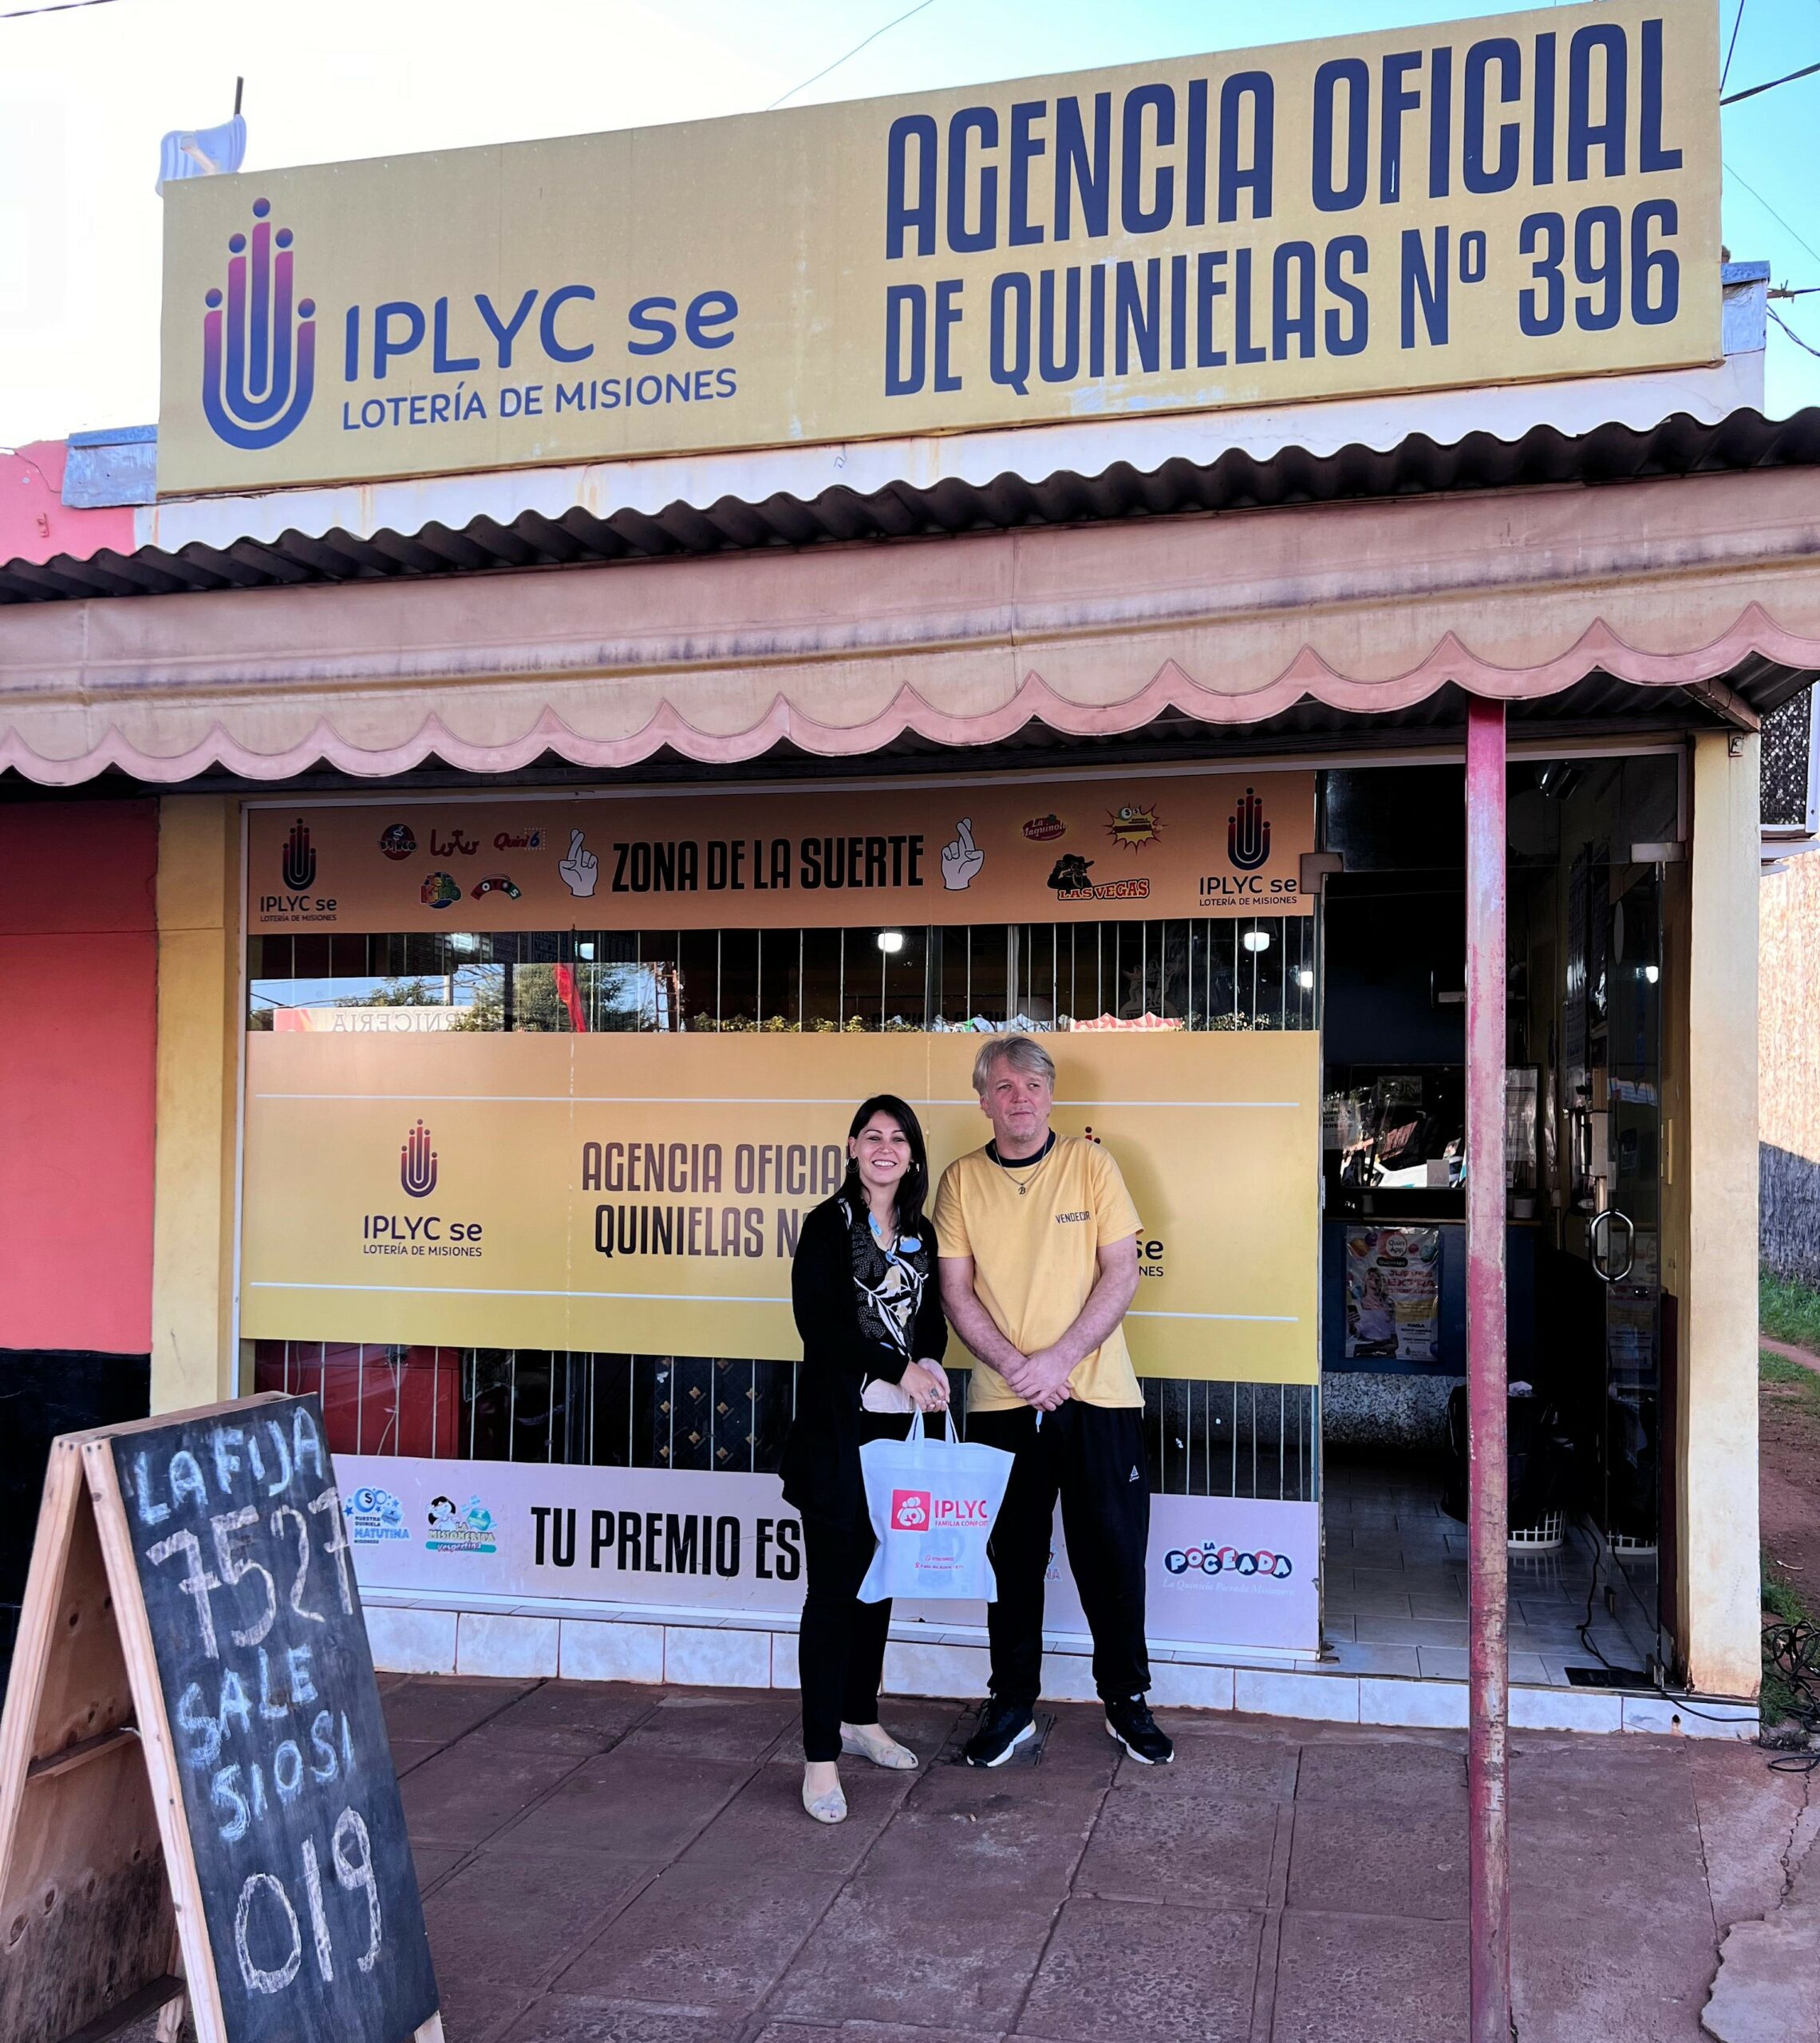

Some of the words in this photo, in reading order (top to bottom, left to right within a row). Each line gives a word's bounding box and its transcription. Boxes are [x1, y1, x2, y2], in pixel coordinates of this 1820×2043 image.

[886, 70, 1274, 260] AGENCIA
[1312, 18, 1683, 212] OFICIAL
[885, 279, 963, 396] DE
[989, 235, 1368, 395] QUINIELAS
[1518, 199, 1679, 337] 396
[345, 284, 595, 382] IPLYC
[627, 289, 739, 356] se
[342, 381, 487, 430] LOTERÍA
[499, 385, 543, 417] DE
[555, 367, 737, 414] MISIONES
[612, 840, 698, 892] ZONA
[707, 840, 745, 891] DE
[753, 838, 791, 889] LA
[800, 835, 924, 889] SUERTE
[1059, 888, 1093, 899] LAS
[1095, 879, 1149, 898] VEGAS
[1200, 876, 1263, 895] IPLYC
[1269, 879, 1297, 892] se
[260, 895, 310, 912] IPLYC
[315, 897, 337, 911] se
[1199, 896, 1237, 907] LOTERÍA
[1253, 895, 1297, 905] MISIONES
[582, 1142, 721, 1194] AGENCIA
[735, 1144, 849, 1195] OFICIA
[364, 1215, 440, 1241] IPLYC
[449, 1222, 483, 1242] se
[594, 1204, 764, 1258] QUINIELAS
[363, 1241, 408, 1255] LOTERÍA
[412, 1246, 426, 1255] DE
[428, 1246, 482, 1257] MISIONES
[934, 1500, 987, 1519] IPLYC
[354, 1527, 410, 1539] MATUTINA
[455, 1521, 468, 1531] LA
[531, 1507, 576, 1567] TU
[590, 1509, 740, 1578] PREMIO
[756, 1518, 800, 1581] ES
[1204, 1542, 1215, 1551] LA
[1167, 1547, 1292, 1577] POCEADA
[177, 1644, 318, 1768] SALE
[235, 1806, 381, 1994] 019
